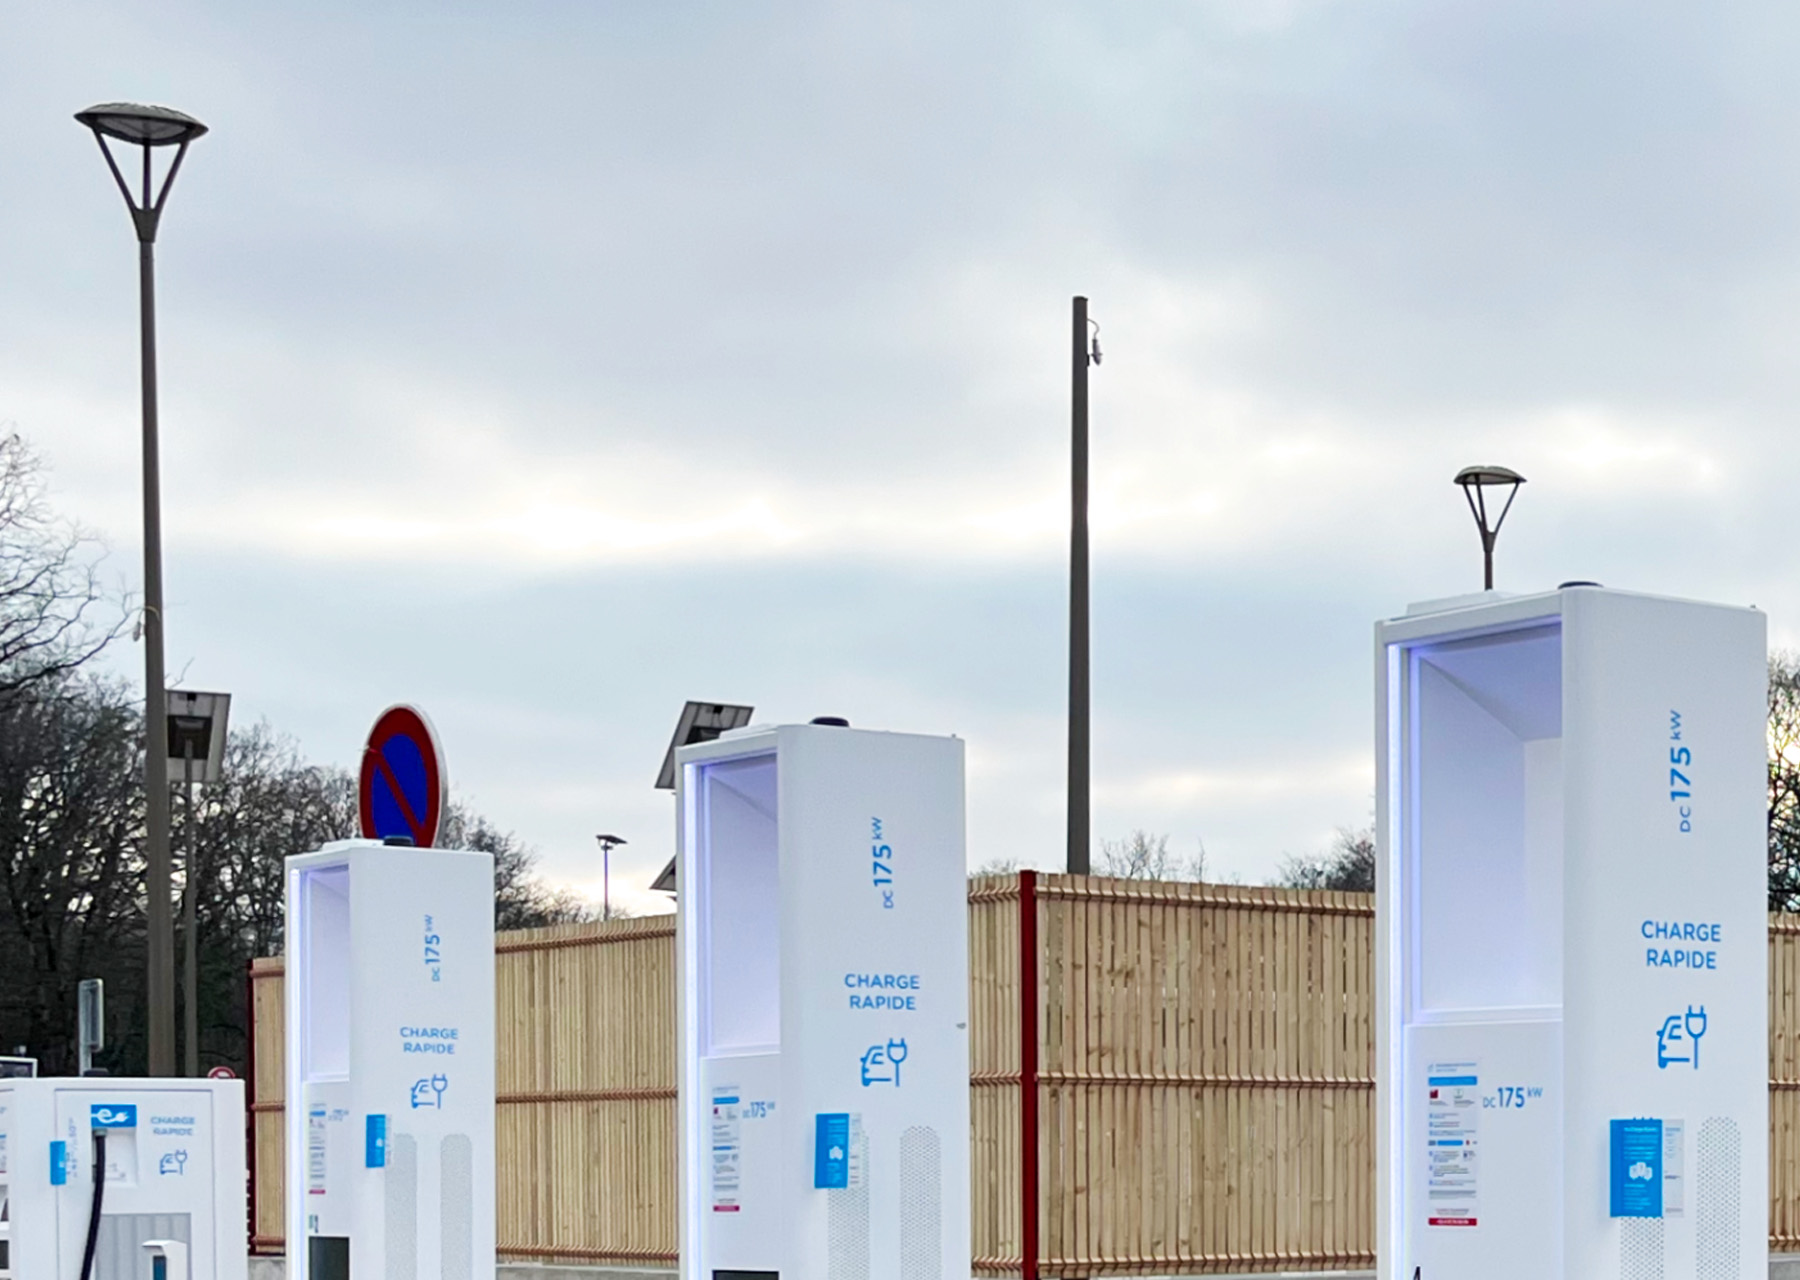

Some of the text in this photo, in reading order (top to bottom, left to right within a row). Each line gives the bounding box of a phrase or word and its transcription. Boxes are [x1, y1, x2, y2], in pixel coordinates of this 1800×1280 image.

[1670, 710, 1691, 832] DC 175 kW
[871, 817, 894, 909] DC 175 kW
[1641, 920, 1721, 942] CHARGE
[424, 934, 441, 965] 175
[1646, 949, 1717, 970] RAPIDE
[844, 973, 920, 989] CHARGE
[849, 995, 916, 1011] RAPIDE
[400, 1027, 459, 1040] CHARGE
[403, 1042, 456, 1055] RAPIDE
[1482, 1097, 1496, 1108] DC
[1497, 1087, 1525, 1108] 175
[1527, 1087, 1543, 1098] kW
